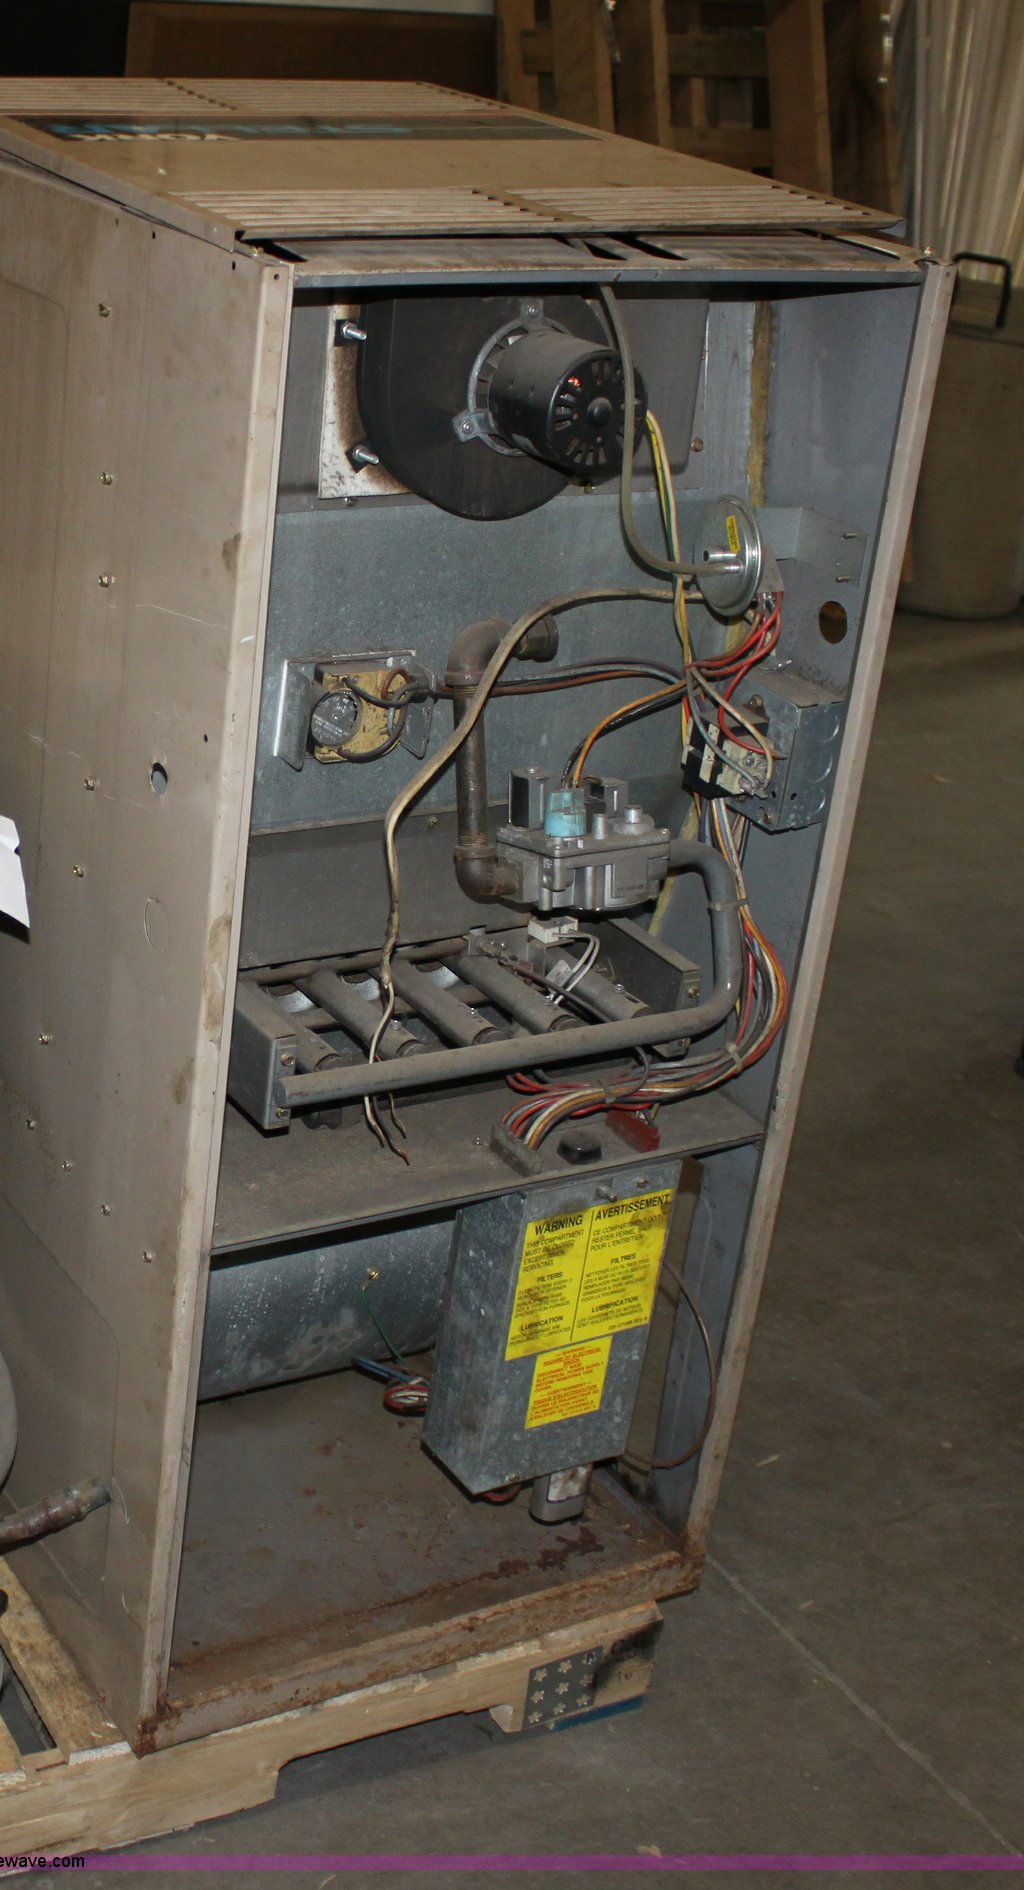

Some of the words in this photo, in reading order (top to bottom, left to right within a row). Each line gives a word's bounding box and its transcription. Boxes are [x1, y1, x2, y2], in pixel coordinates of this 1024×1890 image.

[595, 1194, 670, 1220] AVERTISSEMENT
[534, 1215, 583, 1236] WARNING
[610, 1254, 636, 1264] FILTRES
[536, 1271, 563, 1283] FILTERS
[591, 1296, 638, 1313] LUBRIFICATION
[520, 1314, 563, 1332] LUBRICATION
